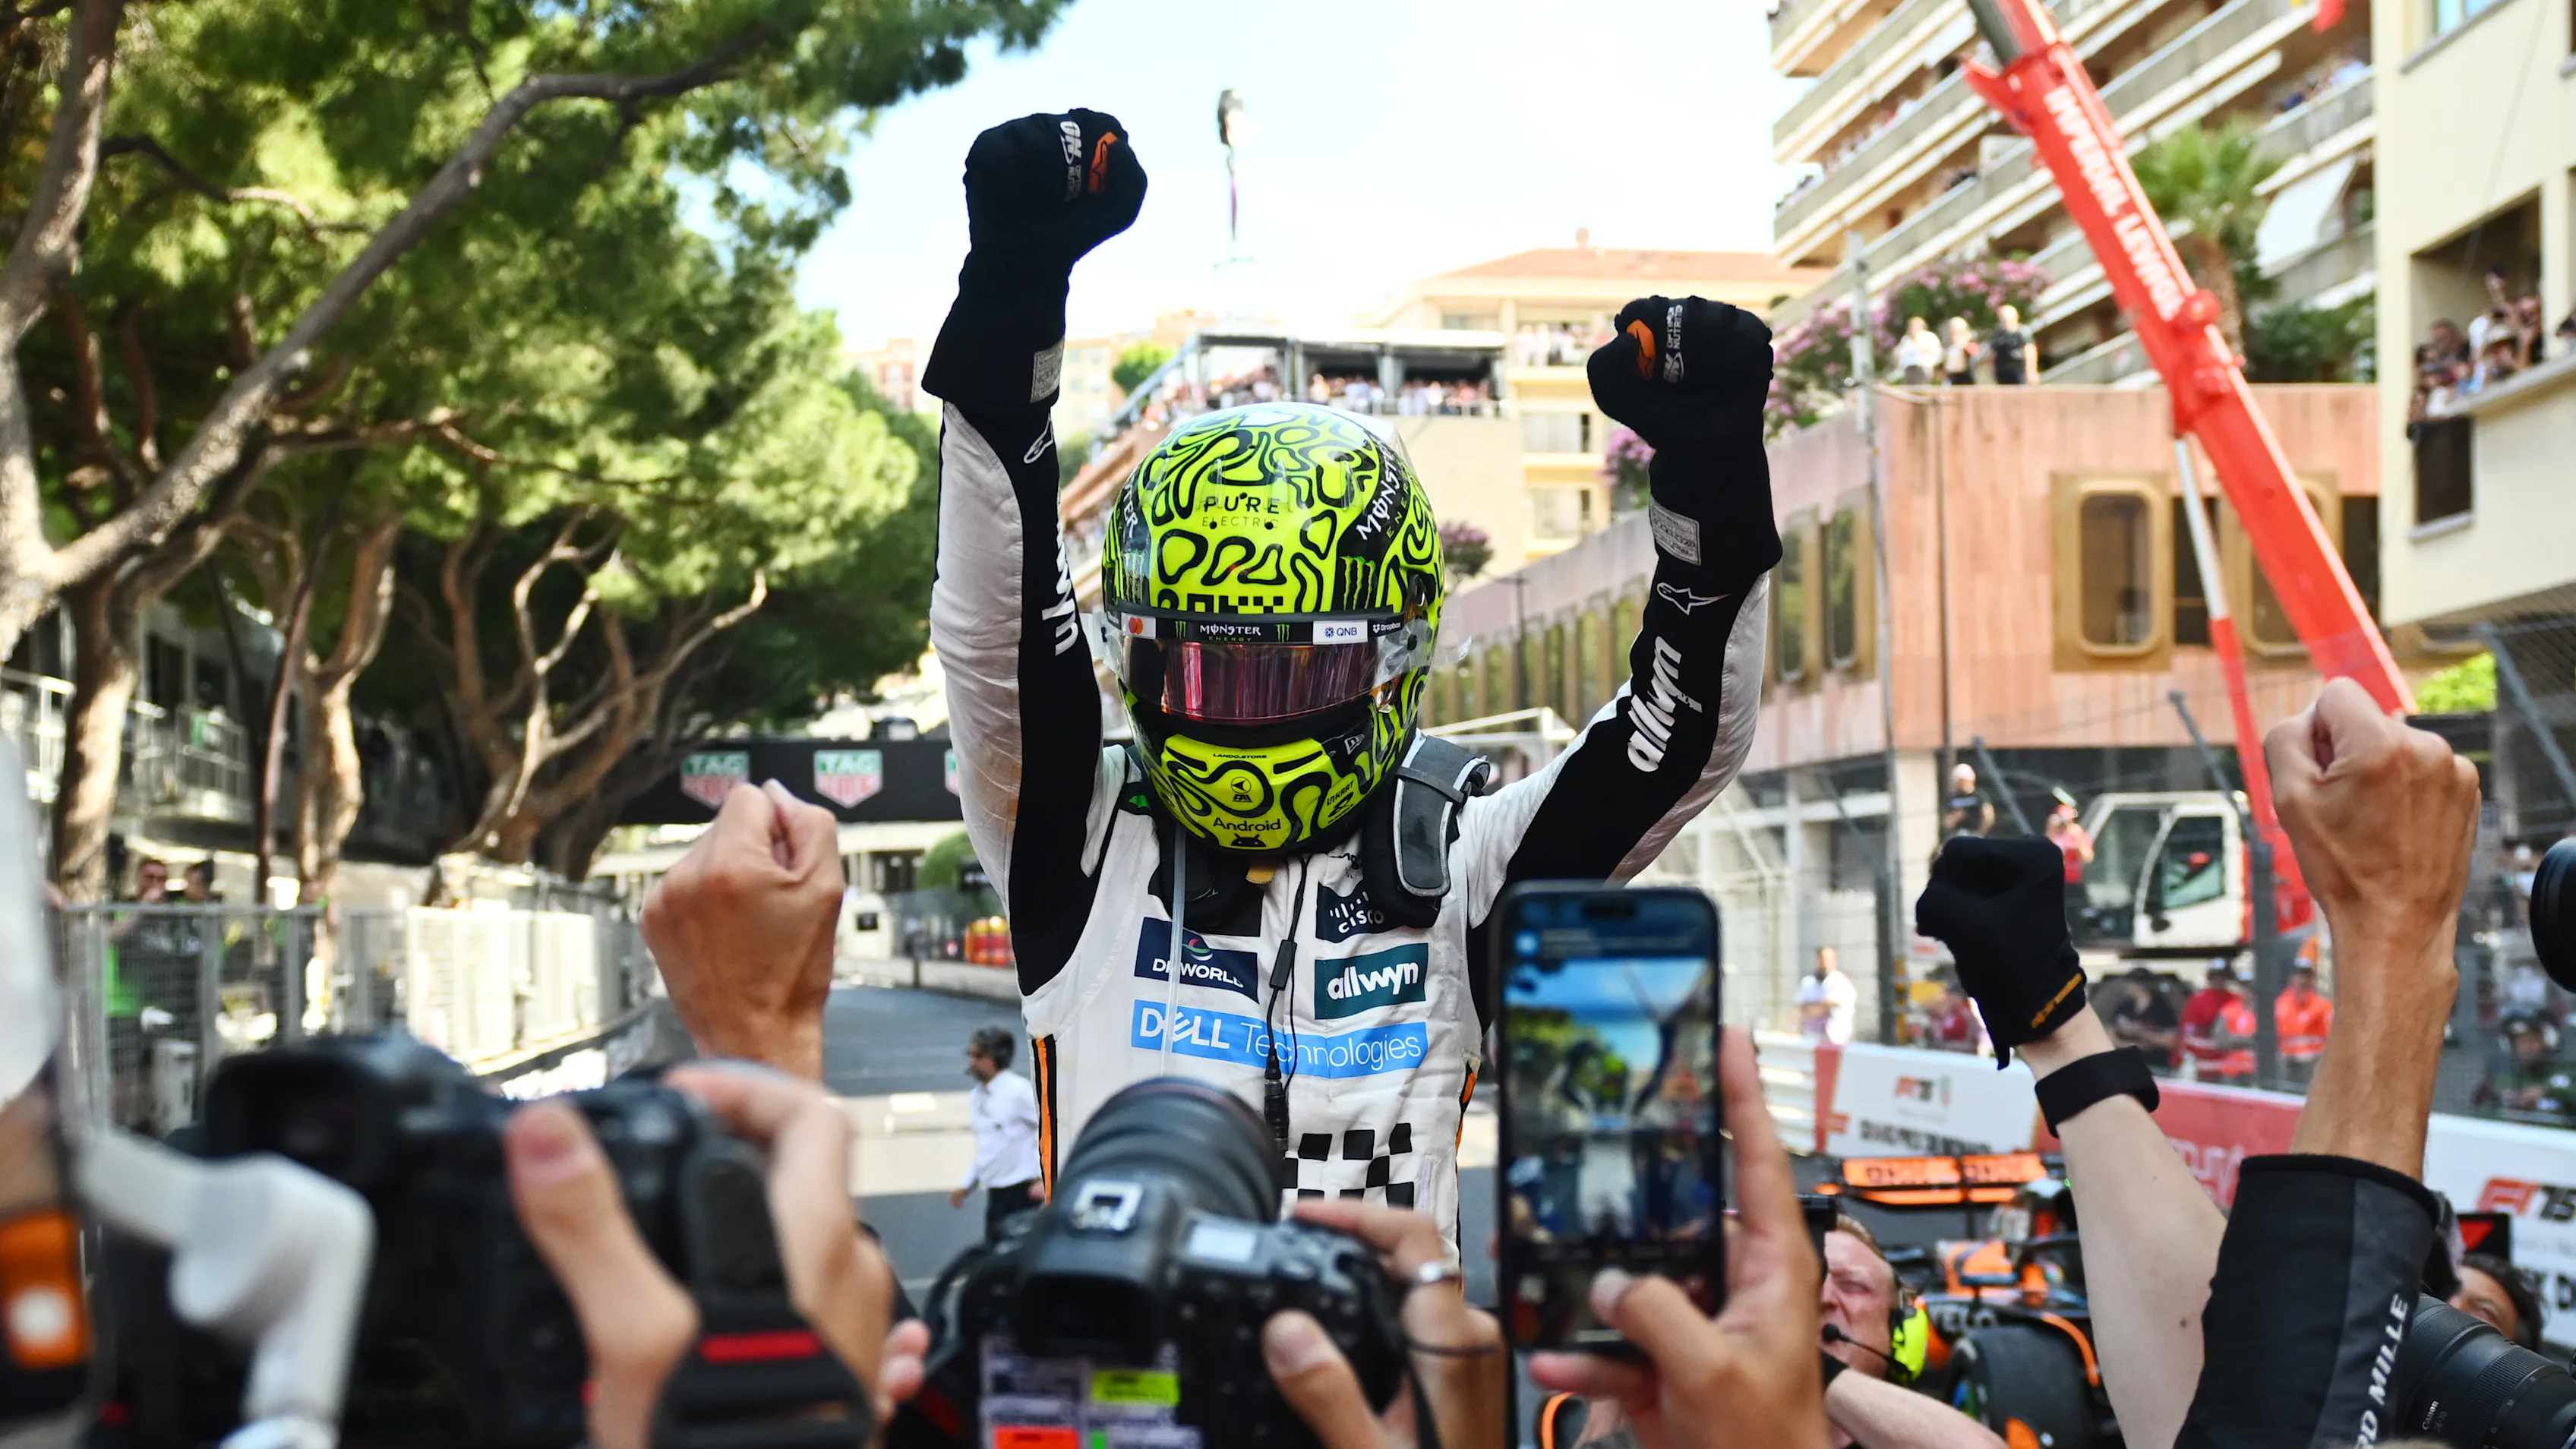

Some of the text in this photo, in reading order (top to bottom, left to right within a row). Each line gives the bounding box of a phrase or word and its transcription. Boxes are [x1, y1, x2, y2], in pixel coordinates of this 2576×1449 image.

[1204, 496, 1280, 514] PURE
[1356, 443, 1400, 541] MONST
[1386, 462, 1411, 538] ENER
[1200, 623, 1261, 636] MONSTER
[1336, 627, 1358, 637] QNB
[1380, 621, 1401, 632] Dropbox
[1627, 636, 1703, 772] allwyn
[819, 752, 878, 773] TAG
[1213, 817, 1281, 832] Android
[1337, 909, 1385, 934] cisco
[1180, 962, 1245, 989] WORLD
[1327, 961, 1419, 1001] allwyn
[1139, 1007, 1422, 1072] DELL Technologies
[2368, 1293, 2409, 1406] MILLE
[2421, 1400, 2439, 1431] Canon
